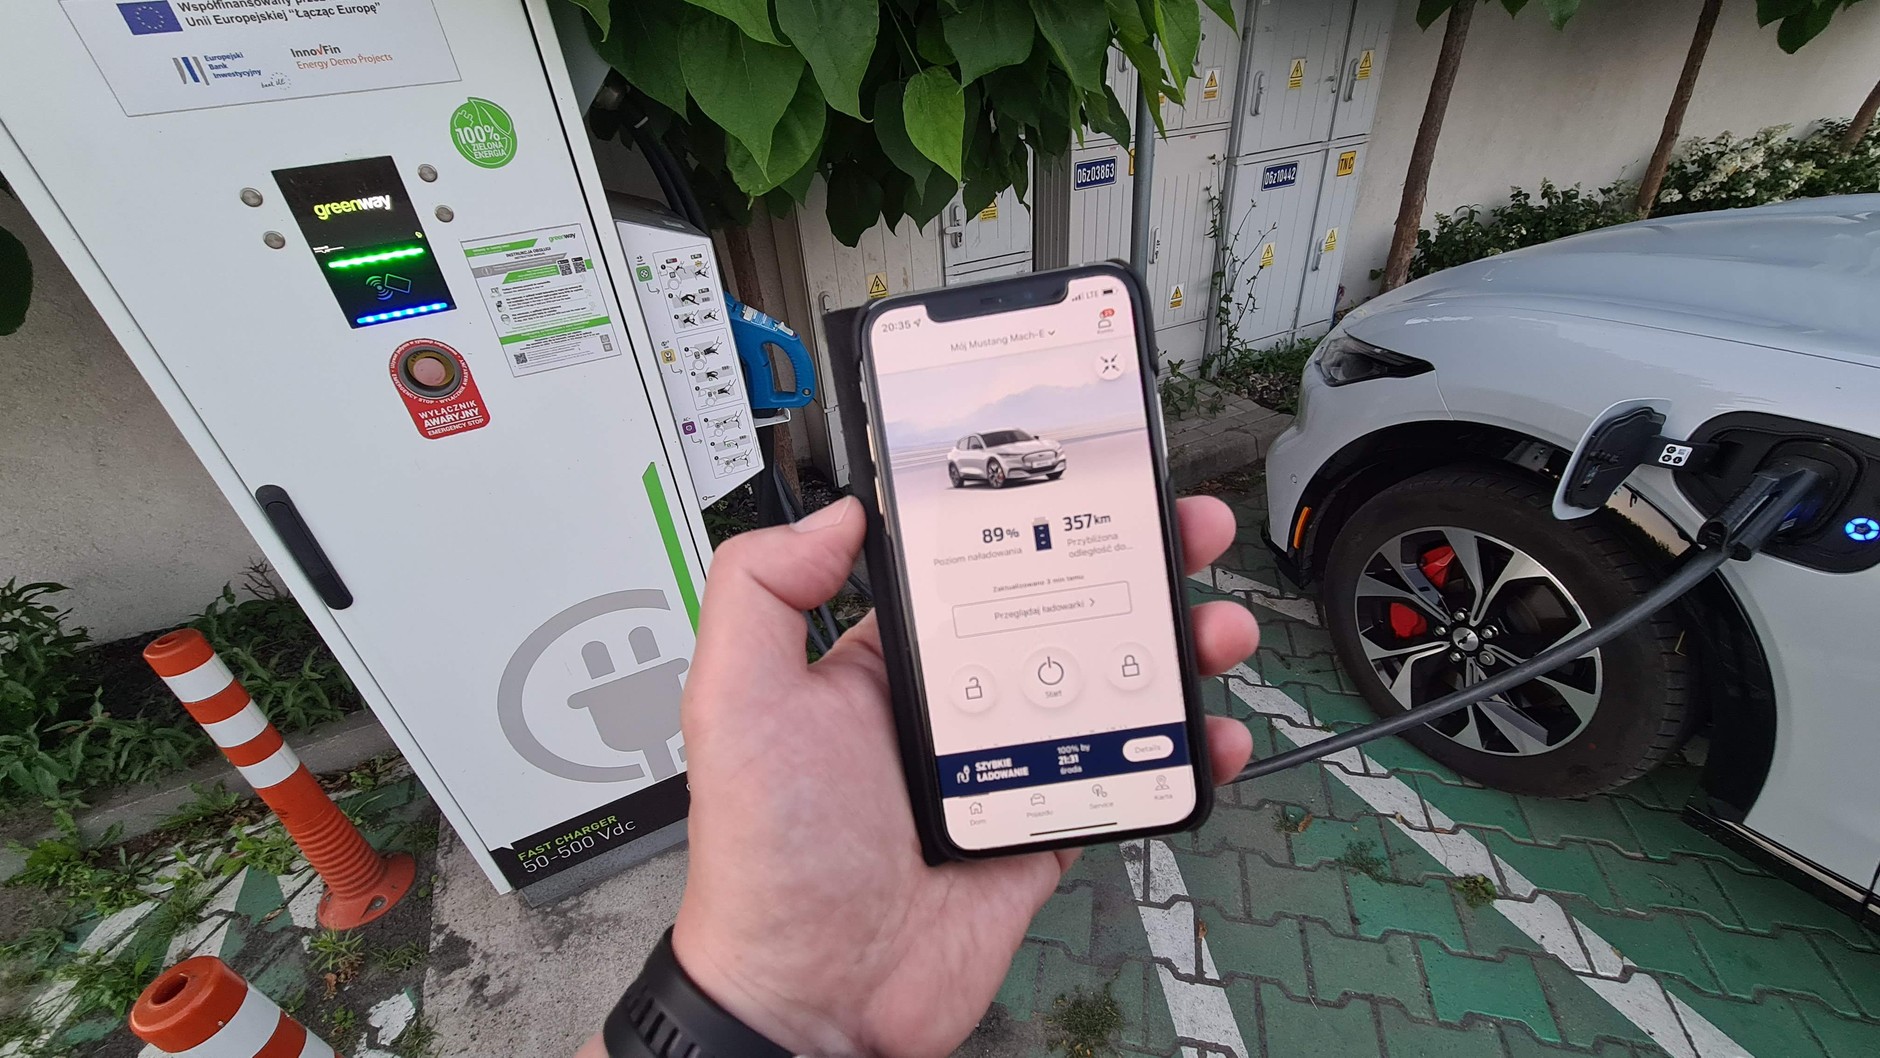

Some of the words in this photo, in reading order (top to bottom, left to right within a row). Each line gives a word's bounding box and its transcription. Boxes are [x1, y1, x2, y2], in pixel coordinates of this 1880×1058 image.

[185, 16, 212, 27] Unii
[213, 9, 288, 25] Europejskiej
[204, 52, 244, 62] Europejski
[296, 60, 329, 70] Energy
[329, 57, 358, 67] Demo
[357, 53, 393, 64] Projects
[208, 62, 229, 71] Bank
[212, 69, 261, 79] Inwestycyjny
[455, 124, 500, 145] 100%
[471, 141, 504, 152] ZIELONA
[473, 149, 507, 159] ENERGIA
[1340, 156, 1354, 171] TNC
[1077, 163, 1115, 184] 06z03863
[1264, 167, 1297, 186] 06z10442
[313, 194, 393, 220] greenway
[548, 232, 576, 243] greenway
[882, 320, 911, 333] 20:35
[950, 342, 968, 353] Mój
[968, 336, 1009, 350] Mustang
[1009, 329, 1044, 342] Mach-E
[418, 400, 477, 419] WYŁĄCZNIK
[424, 407, 479, 428] AWARYJNY
[427, 421, 467, 436] EMERGENCY
[467, 418, 484, 427] STOP
[933, 554, 966, 567] Poziom
[967, 547, 1023, 561] naładowania
[1057, 745, 1080, 755] 100%
[974, 757, 1013, 772] SZYBKIE
[976, 766, 1030, 783] ŁADOWANIE
[517, 841, 552, 861] FAST
[554, 815, 618, 847] CHARGER
[522, 835, 596, 873] 50-500
[597, 820, 637, 841] Vdc
